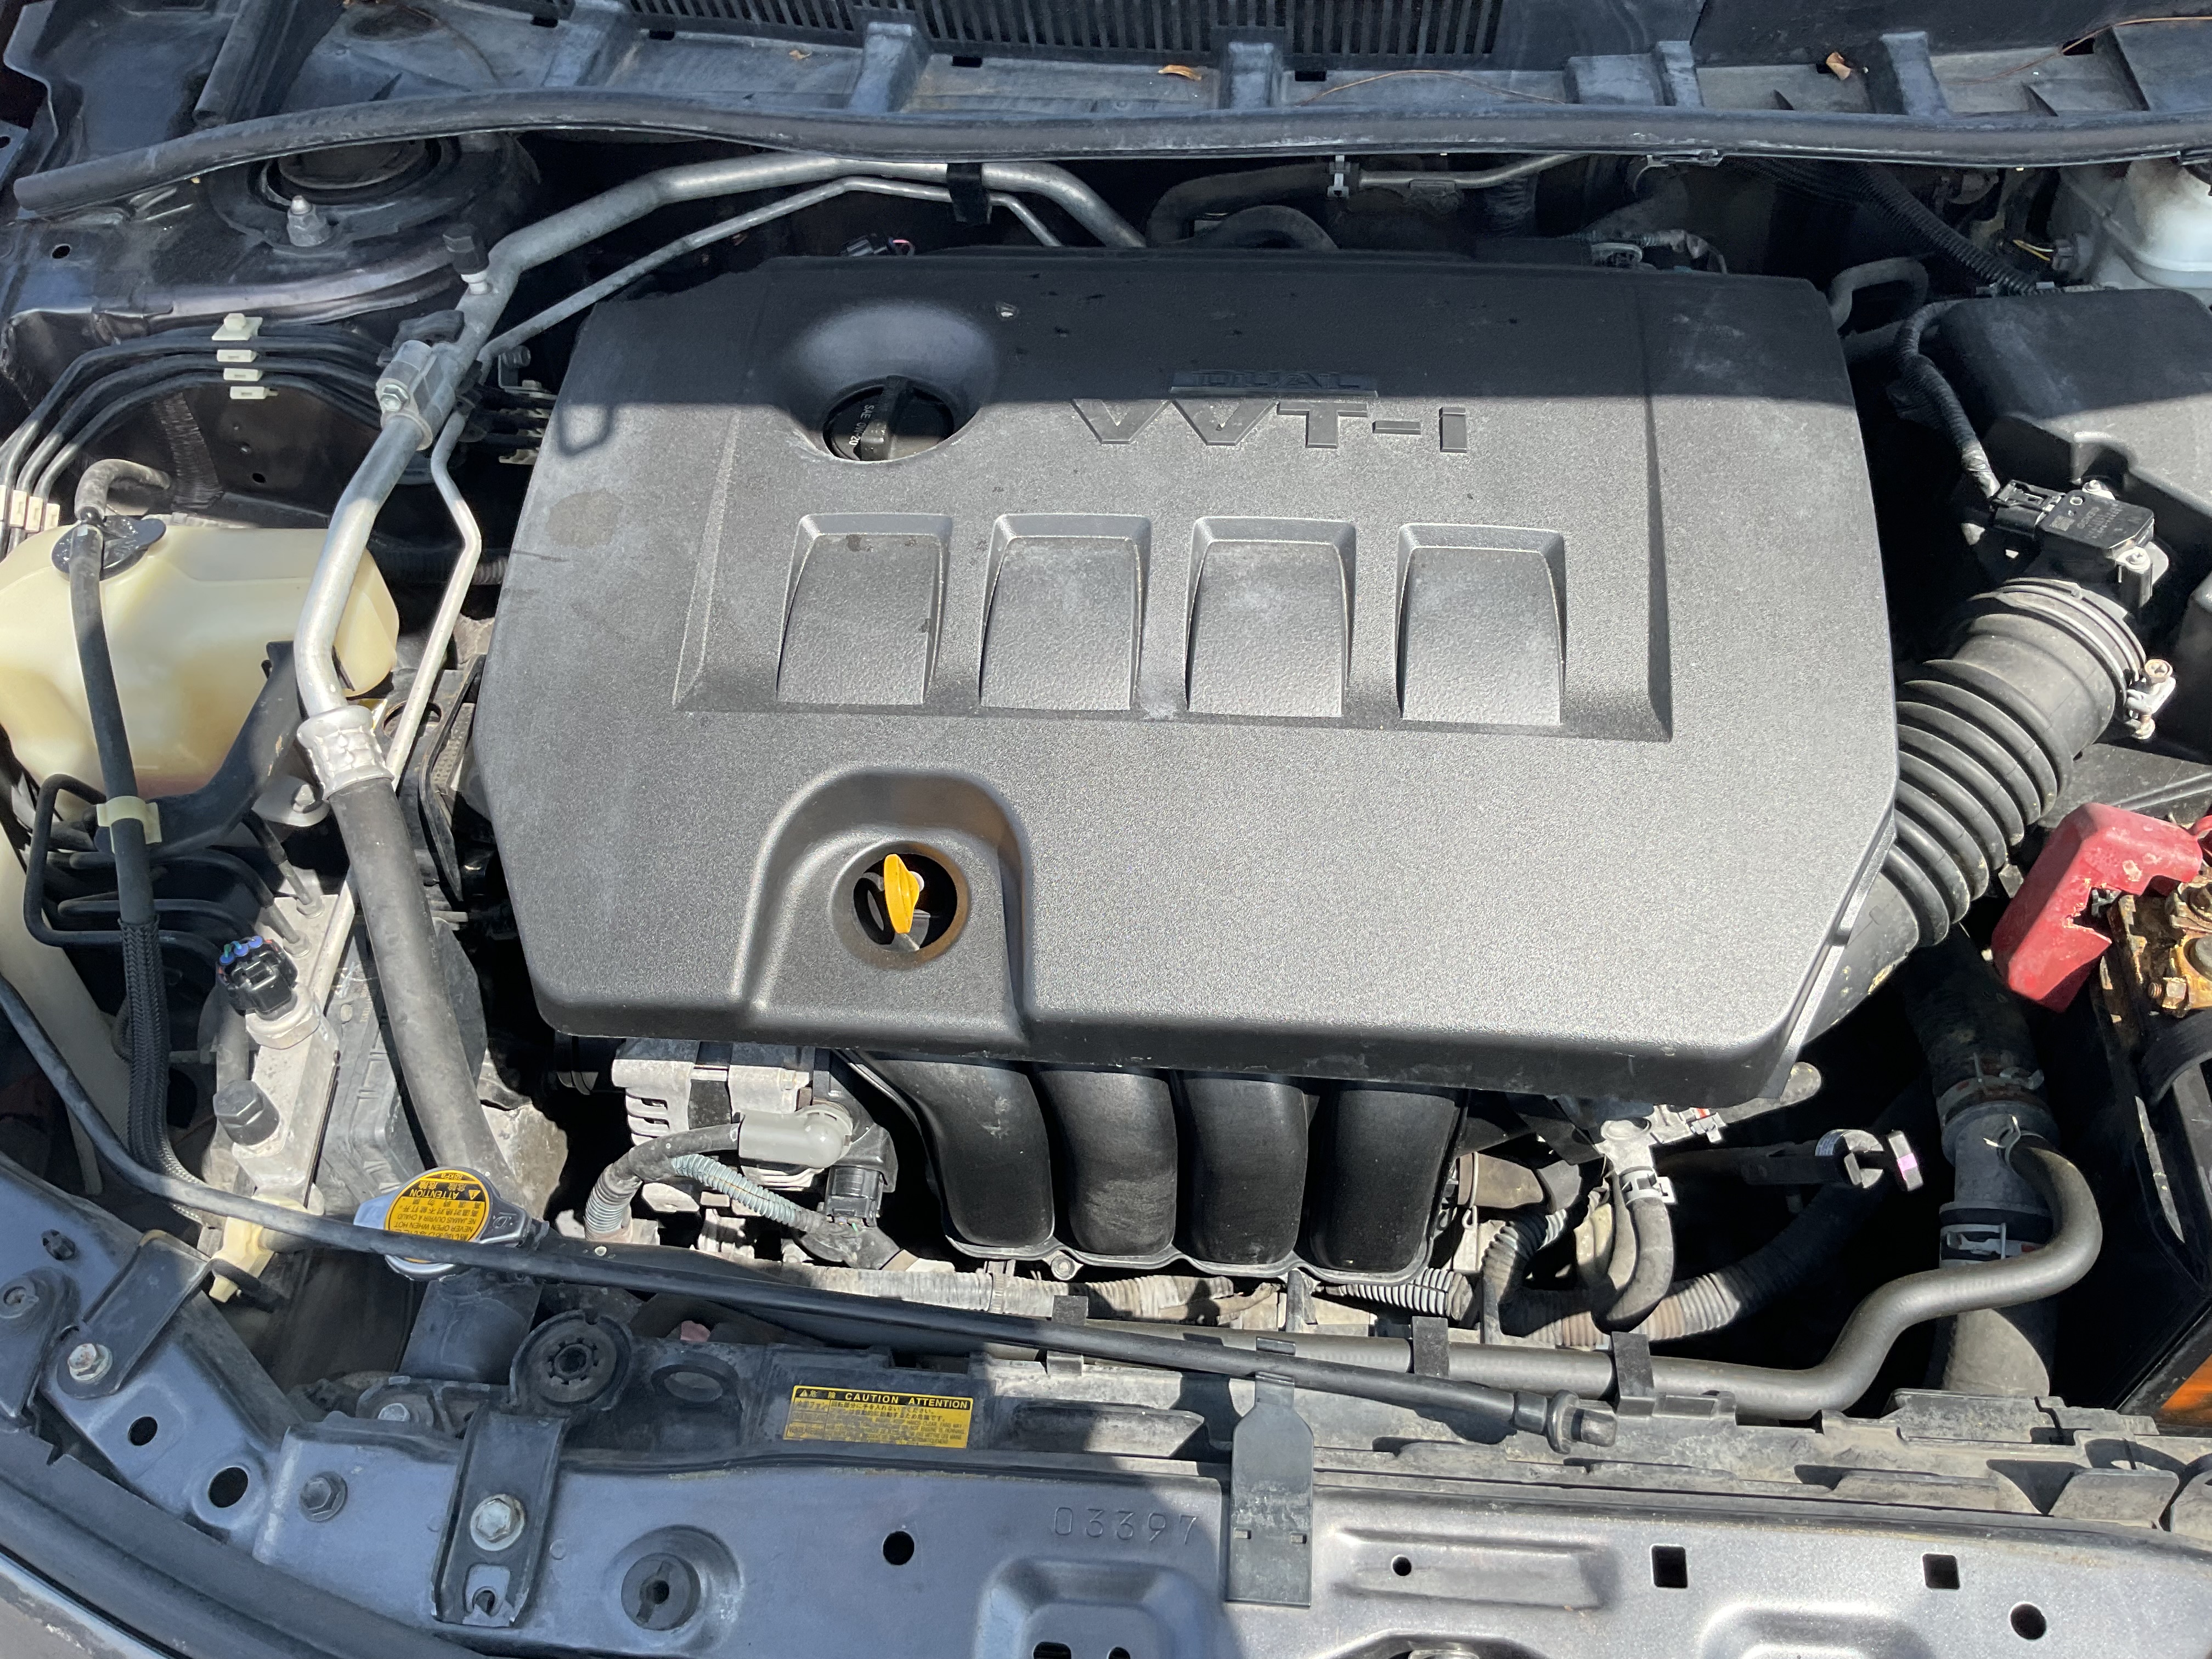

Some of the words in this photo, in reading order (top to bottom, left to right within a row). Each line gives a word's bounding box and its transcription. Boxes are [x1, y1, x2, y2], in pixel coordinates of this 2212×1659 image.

[860, 404, 875, 420] SAE
[409, 1189, 460, 1200] ATTENTION
[845, 1392, 899, 1404] CAUTION
[908, 1397, 967, 1409] ATTENTION
[1053, 1506, 1198, 1545] 03397
